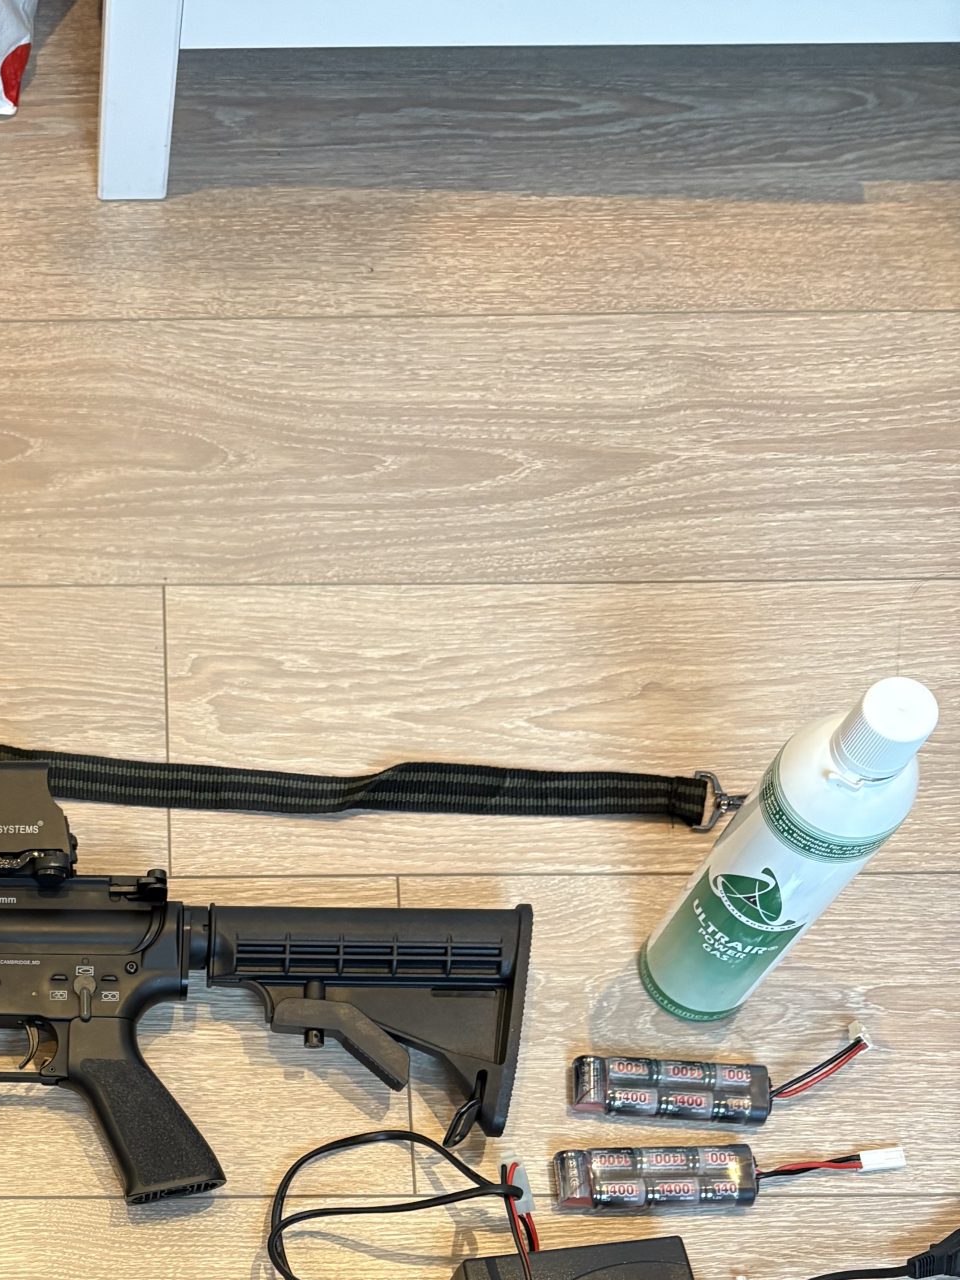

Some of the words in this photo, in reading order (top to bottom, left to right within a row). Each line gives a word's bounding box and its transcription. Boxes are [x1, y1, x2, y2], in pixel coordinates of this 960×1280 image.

[692, 897, 768, 955] ULTRAIR
[697, 927, 746, 959] POWER
[702, 943, 730, 961] GAS
[616, 1091, 647, 1103] 1400
[672, 1094, 704, 1107] 1400
[604, 1184, 634, 1195] 1400
[659, 1183, 690, 1194] 1400
